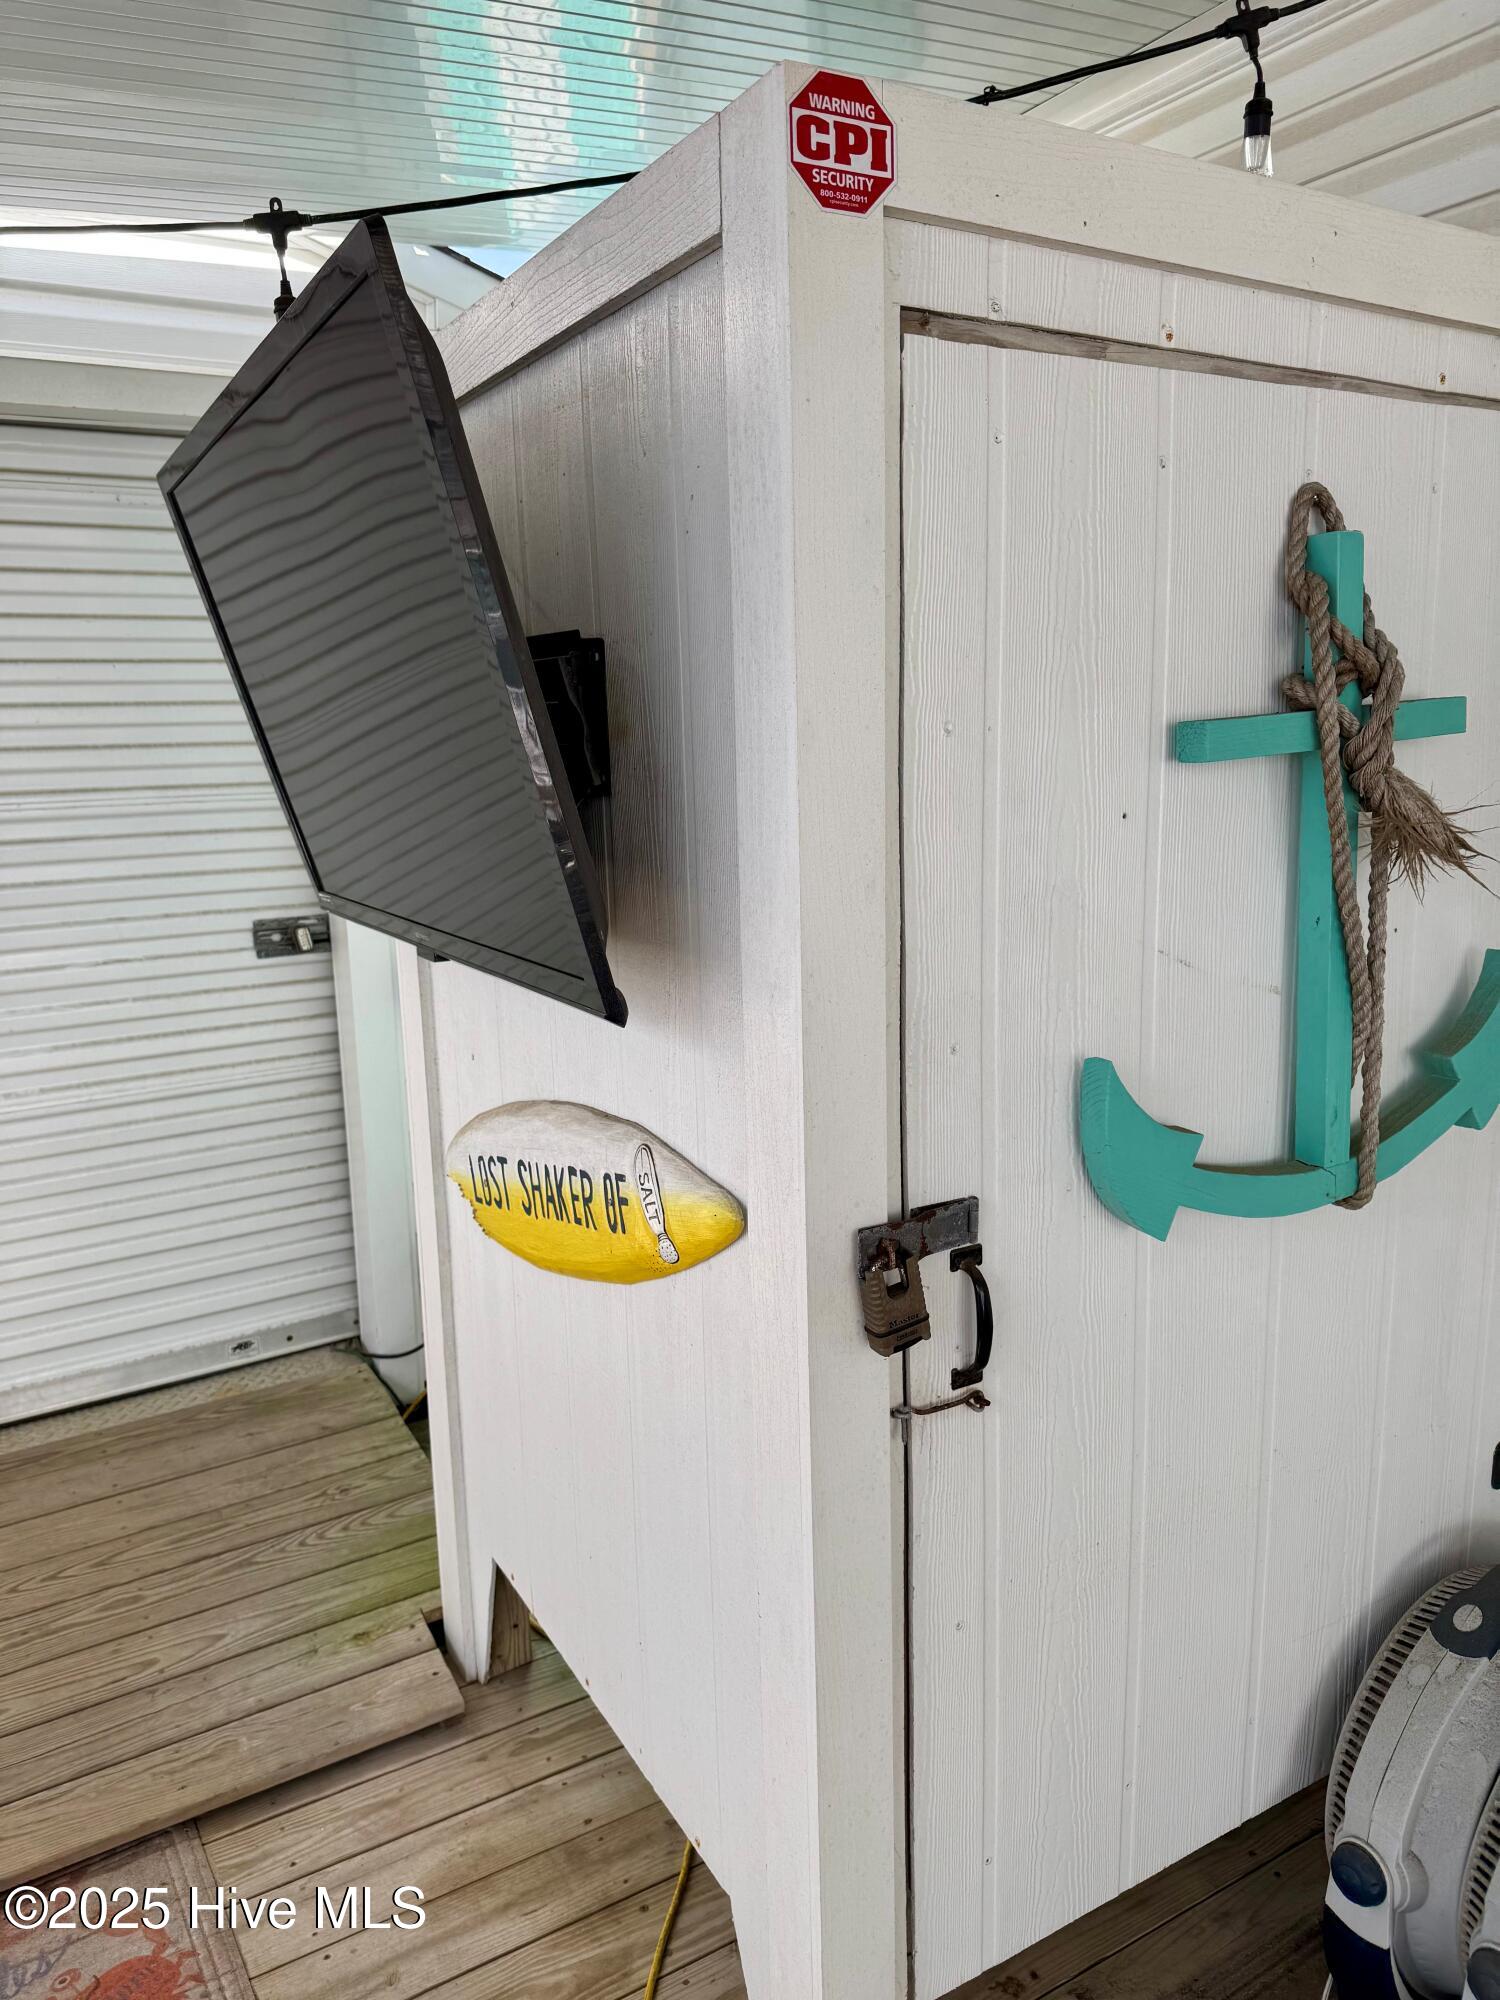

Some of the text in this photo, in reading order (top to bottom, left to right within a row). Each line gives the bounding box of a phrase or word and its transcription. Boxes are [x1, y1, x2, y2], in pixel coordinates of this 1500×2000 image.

[809, 92, 875, 120] WARNING
[796, 114, 888, 172] CPI
[812, 168, 874, 192] SECURITY
[820, 189, 868, 204] 800-532-0911
[469, 1154, 629, 1235] LOST SHAKER OF
[638, 1172, 661, 1225] SALT
[889, 1313, 919, 1329] Master
